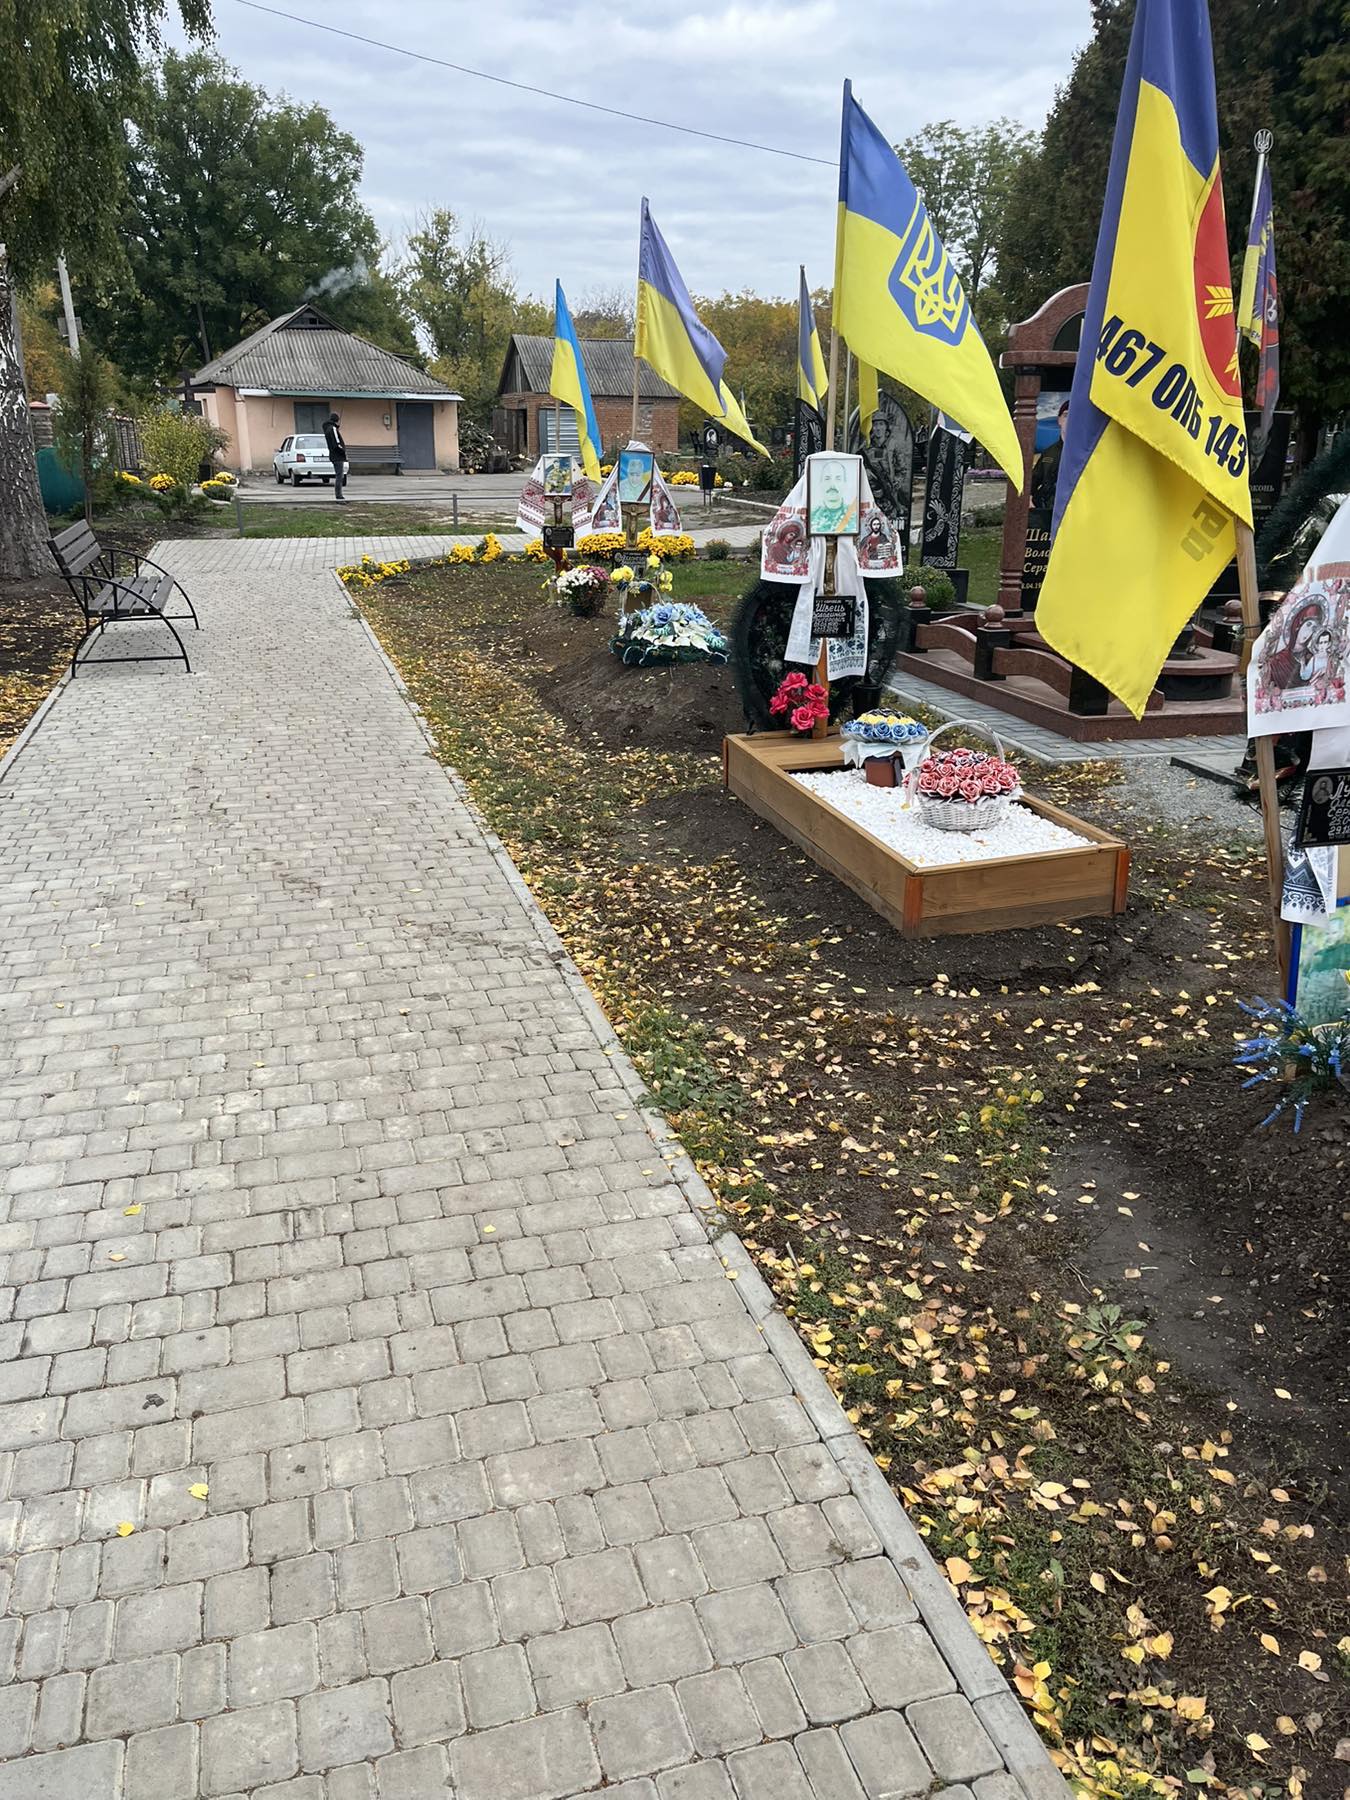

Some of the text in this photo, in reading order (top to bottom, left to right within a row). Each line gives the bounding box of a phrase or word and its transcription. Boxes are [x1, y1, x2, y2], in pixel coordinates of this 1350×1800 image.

[1096, 315, 1248, 478] 467 ОПБ 143
